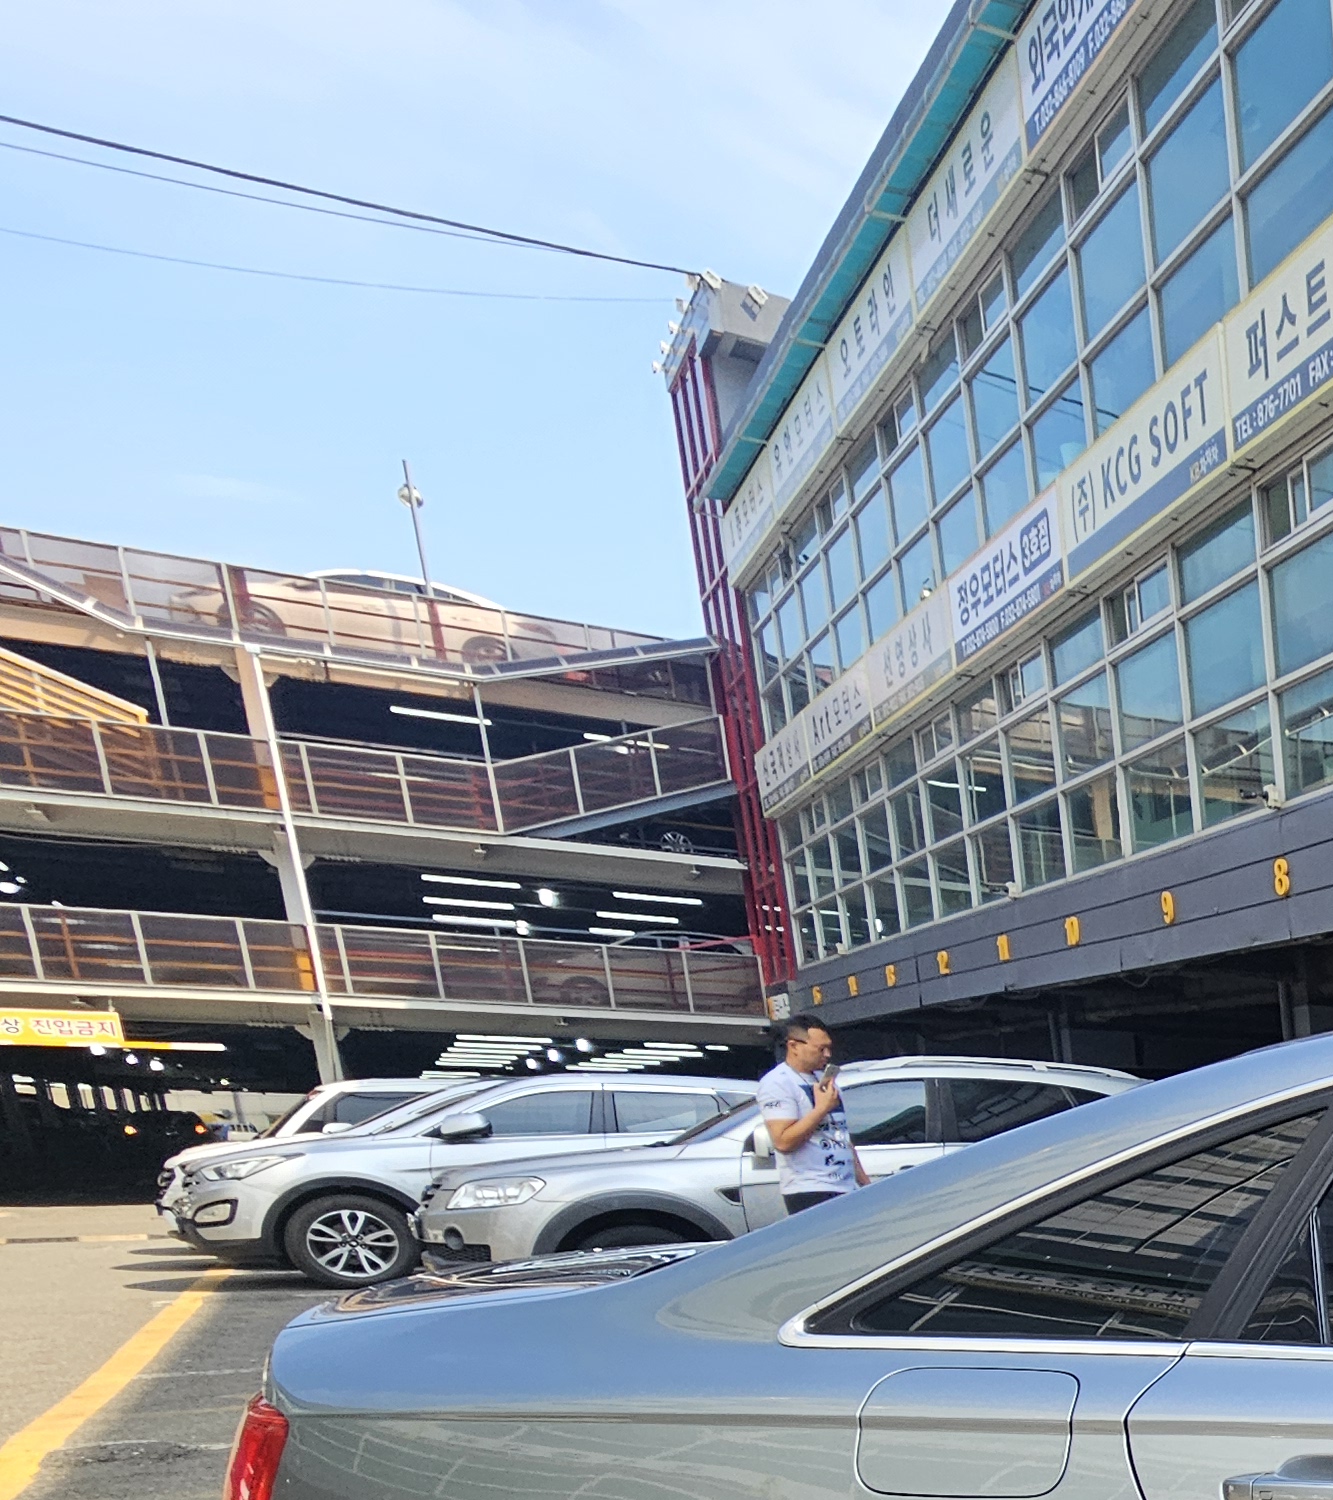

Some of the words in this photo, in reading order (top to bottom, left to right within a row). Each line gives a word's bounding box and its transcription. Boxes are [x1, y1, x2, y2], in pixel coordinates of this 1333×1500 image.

[1028, 0, 1094, 95] 외국인
[1246, 257, 1332, 381] 퍼스트
[1101, 434, 1142, 510] KCG
[1149, 367, 1208, 468] SOFT
[957, 541, 1021, 628] 정우모터스
[1161, 891, 1175, 924] 9
[1273, 856, 1291, 897] 8
[32, 1018, 117, 1037] 진입금지
